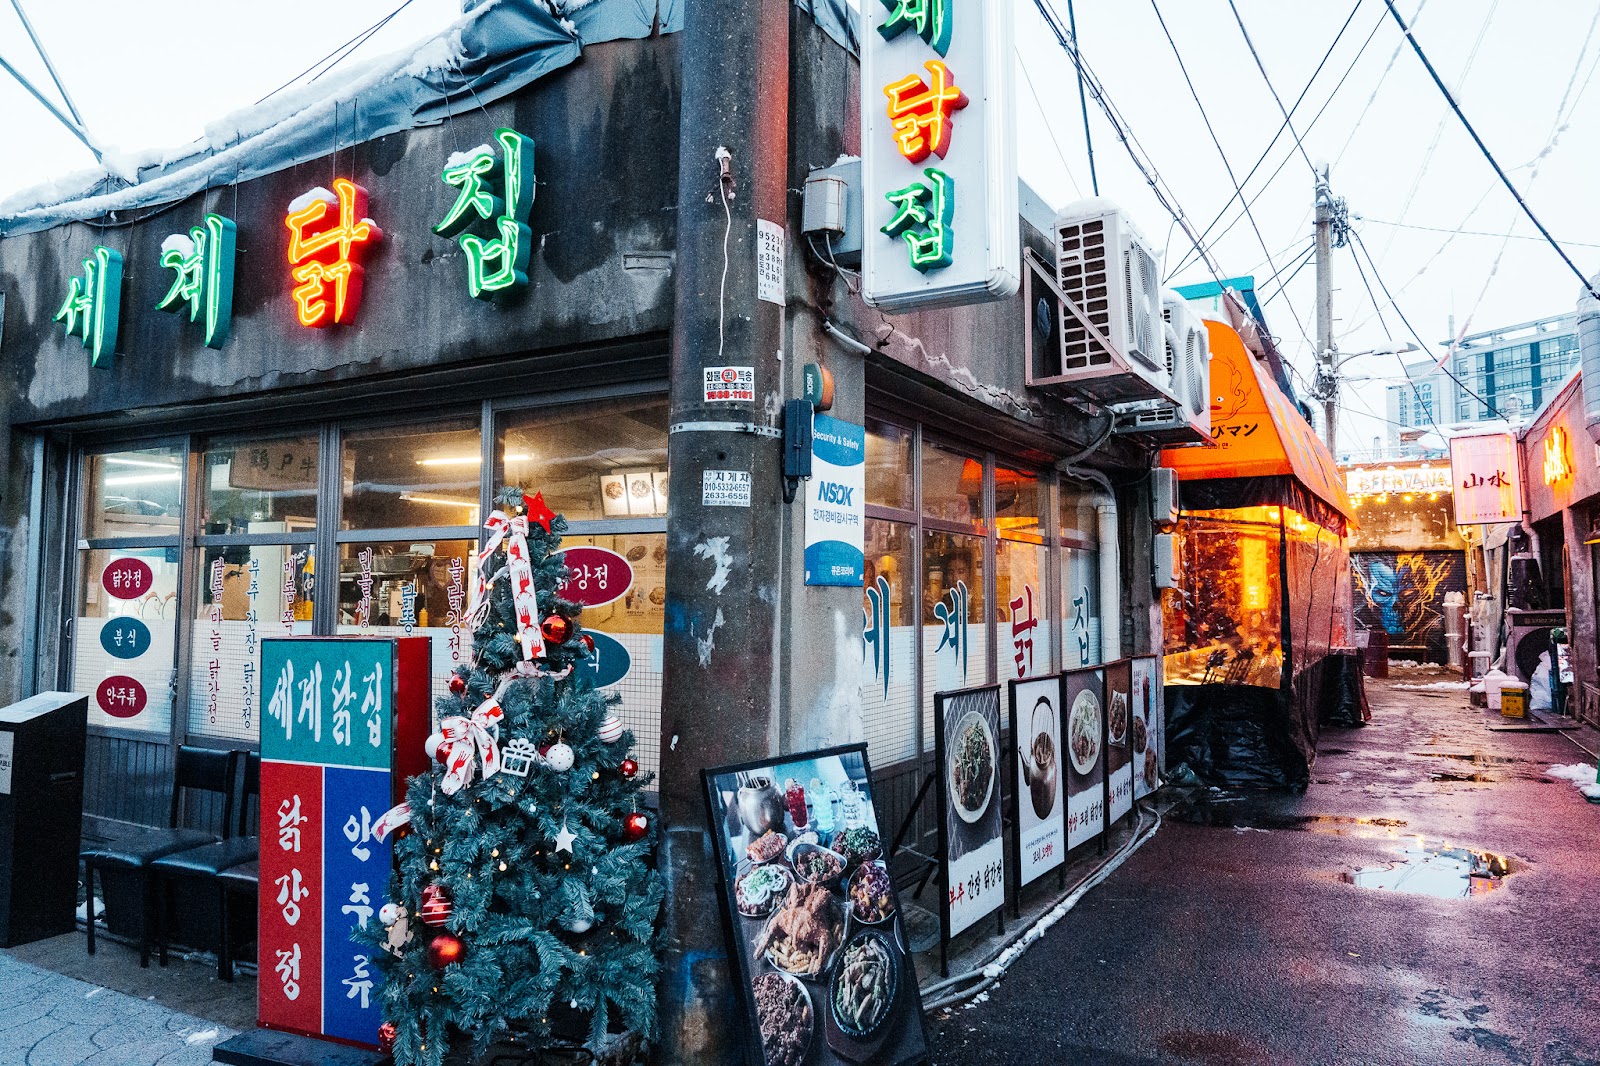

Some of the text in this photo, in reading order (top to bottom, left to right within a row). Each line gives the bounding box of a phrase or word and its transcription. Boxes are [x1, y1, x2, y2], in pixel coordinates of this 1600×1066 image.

[706, 371, 721, 382] 화물
[738, 370, 752, 382] 특송
[806, 373, 814, 396] NSOK
[813, 428, 837, 446] Security
[843, 436, 860, 452] Safety
[1463, 469, 1511, 489] 山水
[817, 480, 855, 507] NSOK
[812, 508, 860, 527] 전자경비감시구역
[112, 568, 142, 589] 닭강정
[113, 628, 138, 648] 분식
[210, 608, 223, 652] 마늘
[241, 558, 260, 730] 부추 간장 닭강정
[106, 687, 138, 708] 안주류
[206, 657, 221, 725] 닭강정
[267, 658, 384, 749] 세계닭집
[949, 858, 1003, 911] 부추 간장 닭강정
[274, 794, 309, 1002] 닭강정
